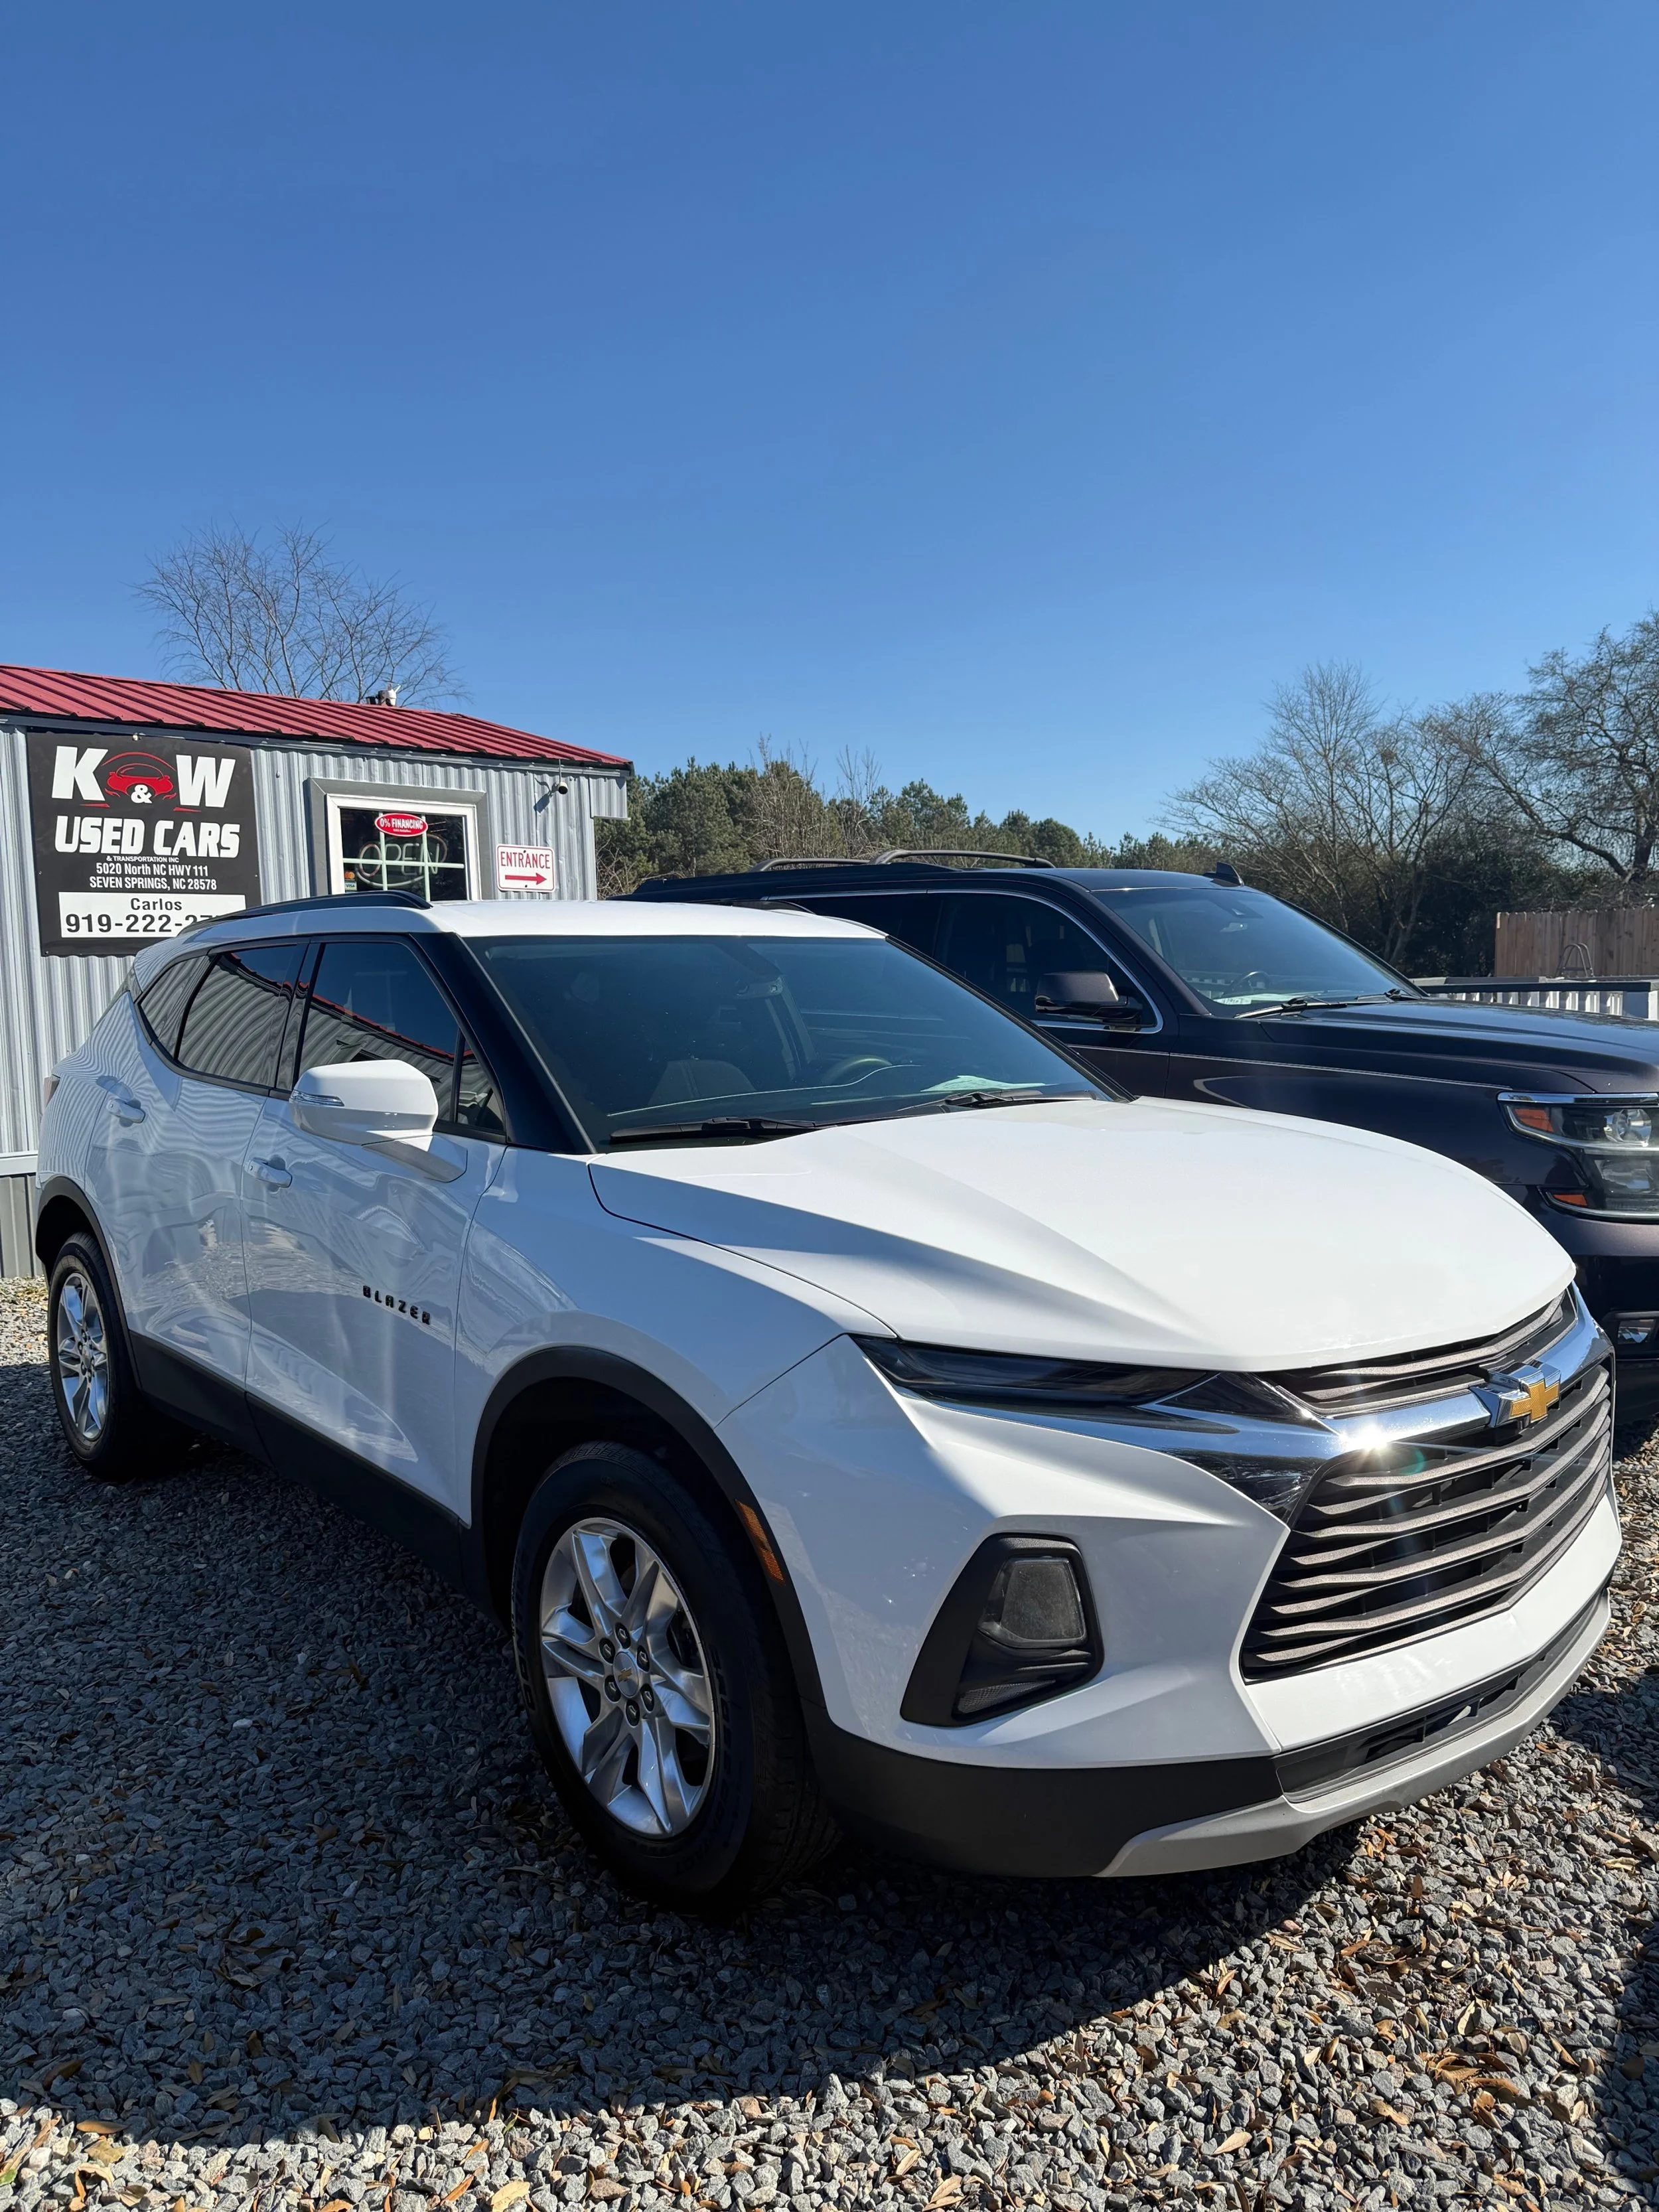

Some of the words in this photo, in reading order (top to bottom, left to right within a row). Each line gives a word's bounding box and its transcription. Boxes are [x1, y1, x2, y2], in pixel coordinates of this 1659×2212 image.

[52, 745, 108, 801] K
[131, 784, 153, 804] &
[175, 754, 236, 808] W
[380, 818, 391, 828] 0%
[392, 818, 423, 830] FINANCING
[54, 815, 145, 855] USED
[153, 820, 240, 858] CARS
[359, 843, 440, 877] OPEN
[500, 851, 550, 869] ENTRANCE
[96, 862, 121, 875] 5020
[124, 863, 151, 875] North
[153, 863, 167, 875] NC
[169, 864, 191, 876] HWY
[193, 865, 208, 877] 111
[90, 876, 123, 889] SEVEN
[124, 877, 171, 891] SPRINGS,
[173, 878, 186, 889] NC
[187, 879, 217, 891] 28578
[130, 897, 182, 911] Carlos
[362, 1285, 431, 1325] BLAZER
